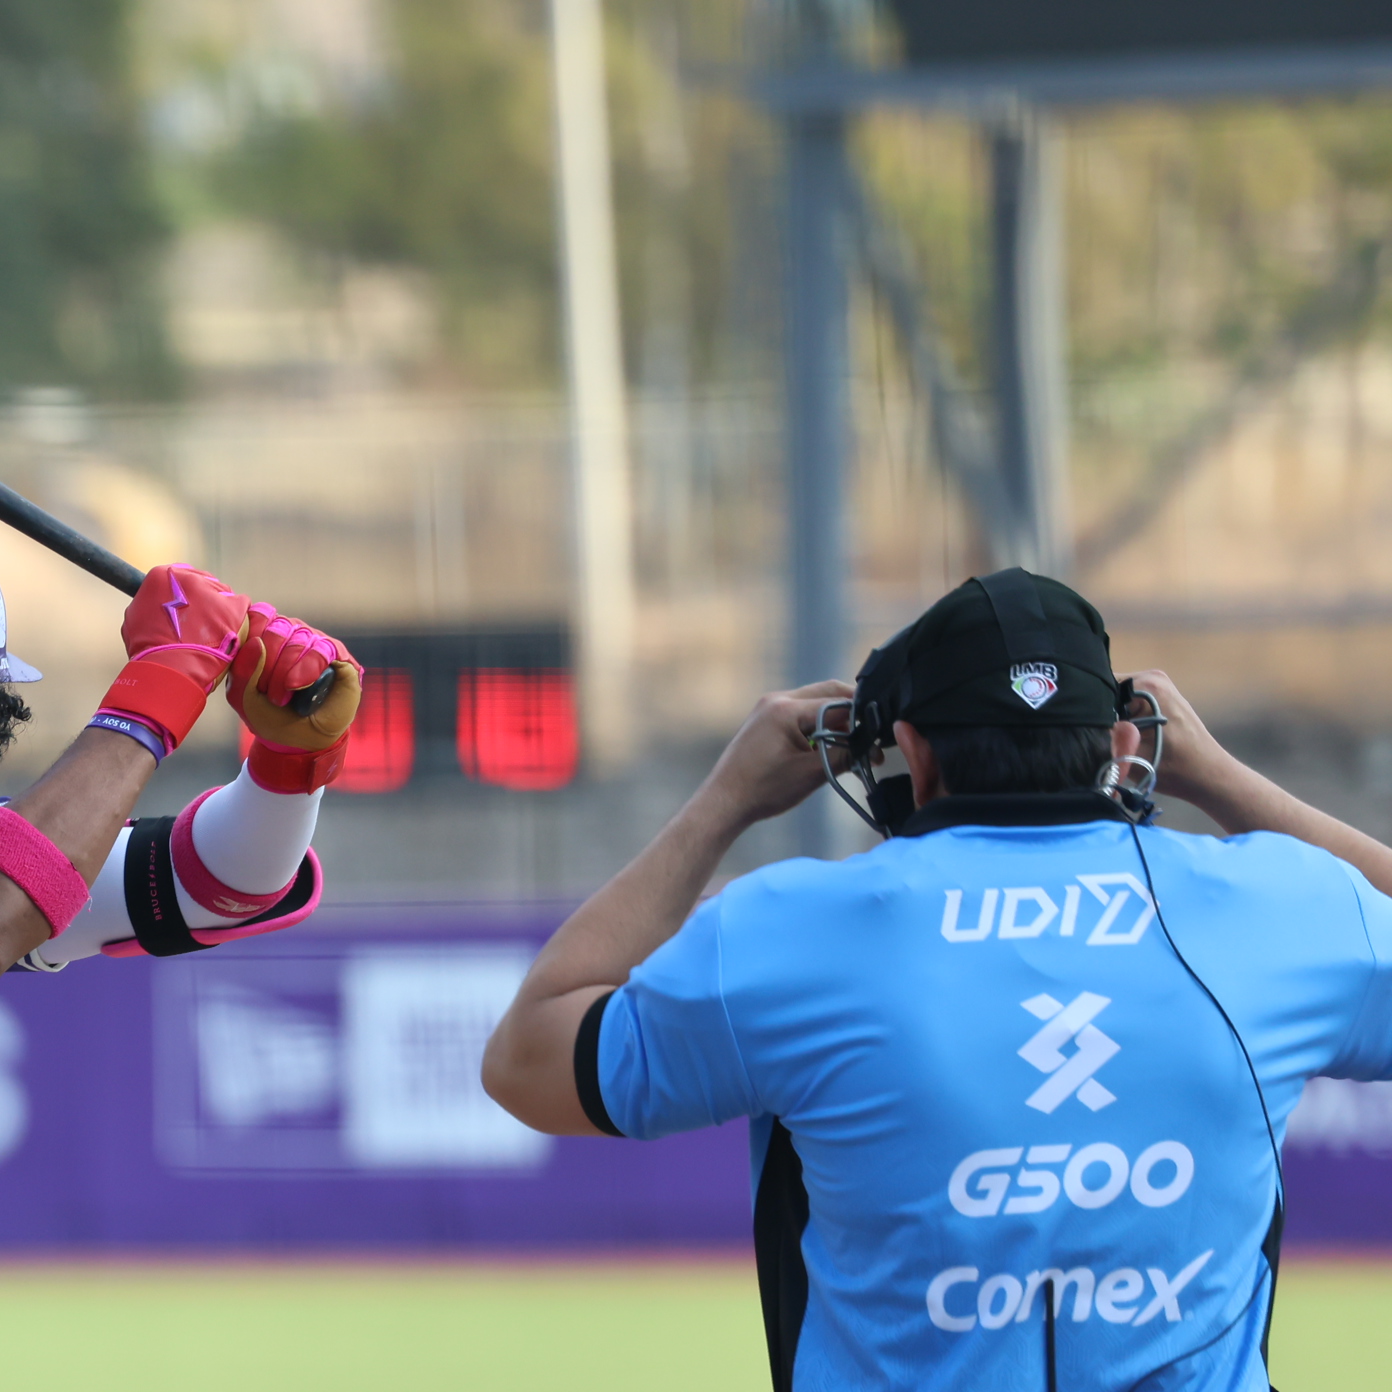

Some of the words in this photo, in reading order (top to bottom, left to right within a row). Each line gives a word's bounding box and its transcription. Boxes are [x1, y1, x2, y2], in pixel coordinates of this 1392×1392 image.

[149, 881, 162, 921] BRUCE
[948, 1140, 1194, 1218] G500
[926, 1247, 1214, 1332] Comex
